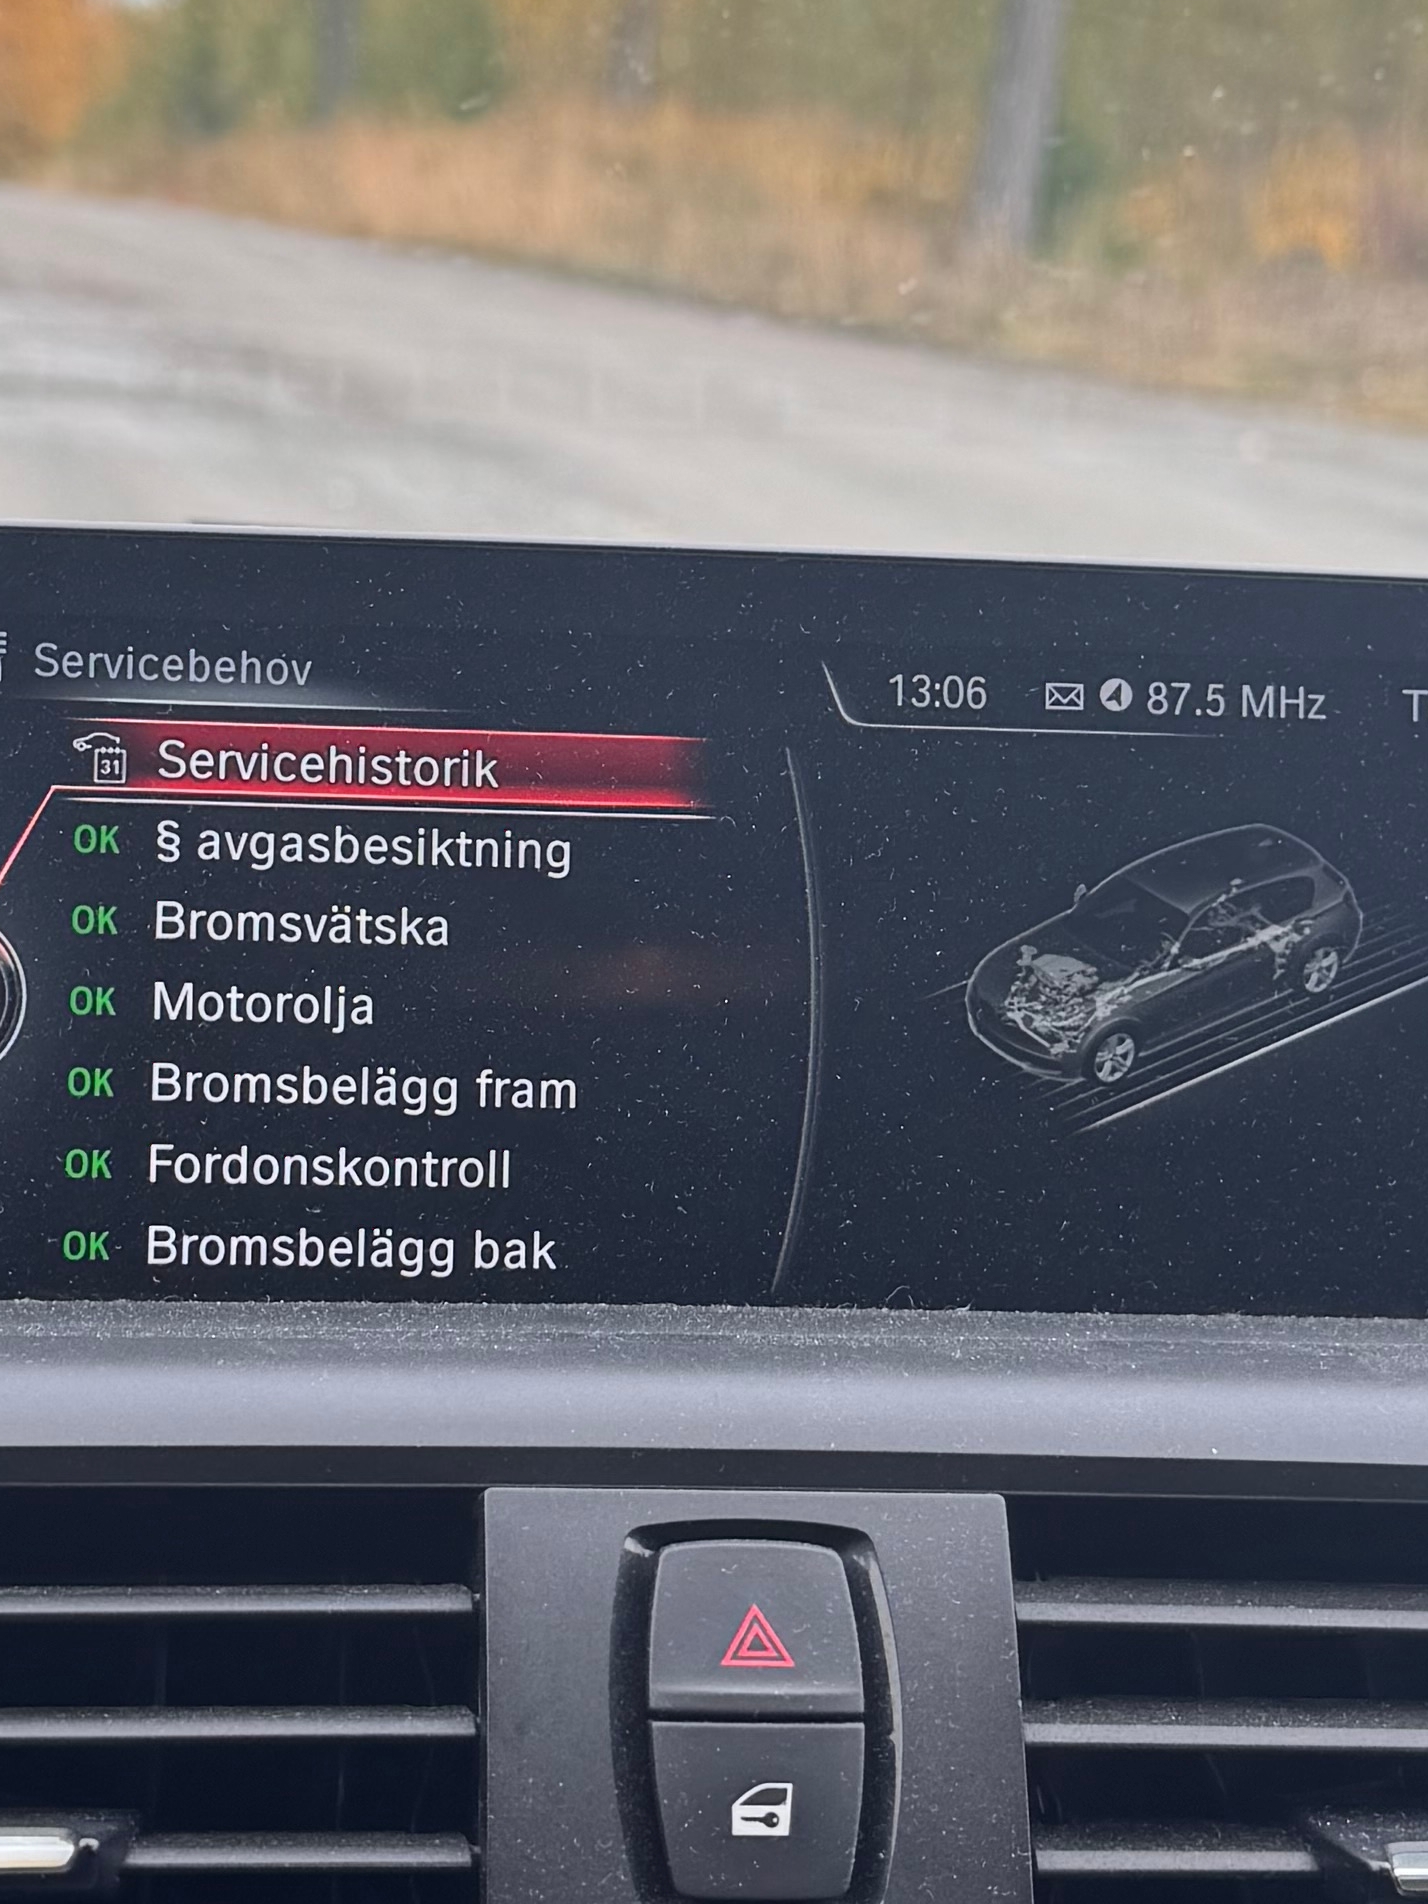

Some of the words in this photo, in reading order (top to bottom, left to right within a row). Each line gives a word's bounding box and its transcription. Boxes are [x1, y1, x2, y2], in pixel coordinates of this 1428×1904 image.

[33, 642, 313, 687] Servicebehov
[890, 674, 986, 709] 13:06
[1148, 682, 1224, 716] 87.5
[1242, 685, 1326, 719] MHz
[100, 759, 120, 775] 31
[158, 739, 500, 790] Servicehistorik
[74, 825, 119, 853] OK
[157, 820, 180, 862] §
[198, 826, 573, 879] avgasbesiktning
[72, 905, 117, 934] OK
[156, 901, 448, 946] Bromsvätska
[70, 986, 115, 1015] OK
[154, 982, 372, 1033] Motorolja
[68, 1068, 113, 1096] OK
[152, 1063, 457, 1116] Bromsbelägg
[476, 1069, 575, 1108] fram
[65, 1149, 111, 1178] OK
[150, 1144, 509, 1188] Fordonskontroll
[64, 1231, 109, 1260] OK
[148, 1226, 453, 1277] Bromsbelägg
[475, 1230, 556, 1269] bak
